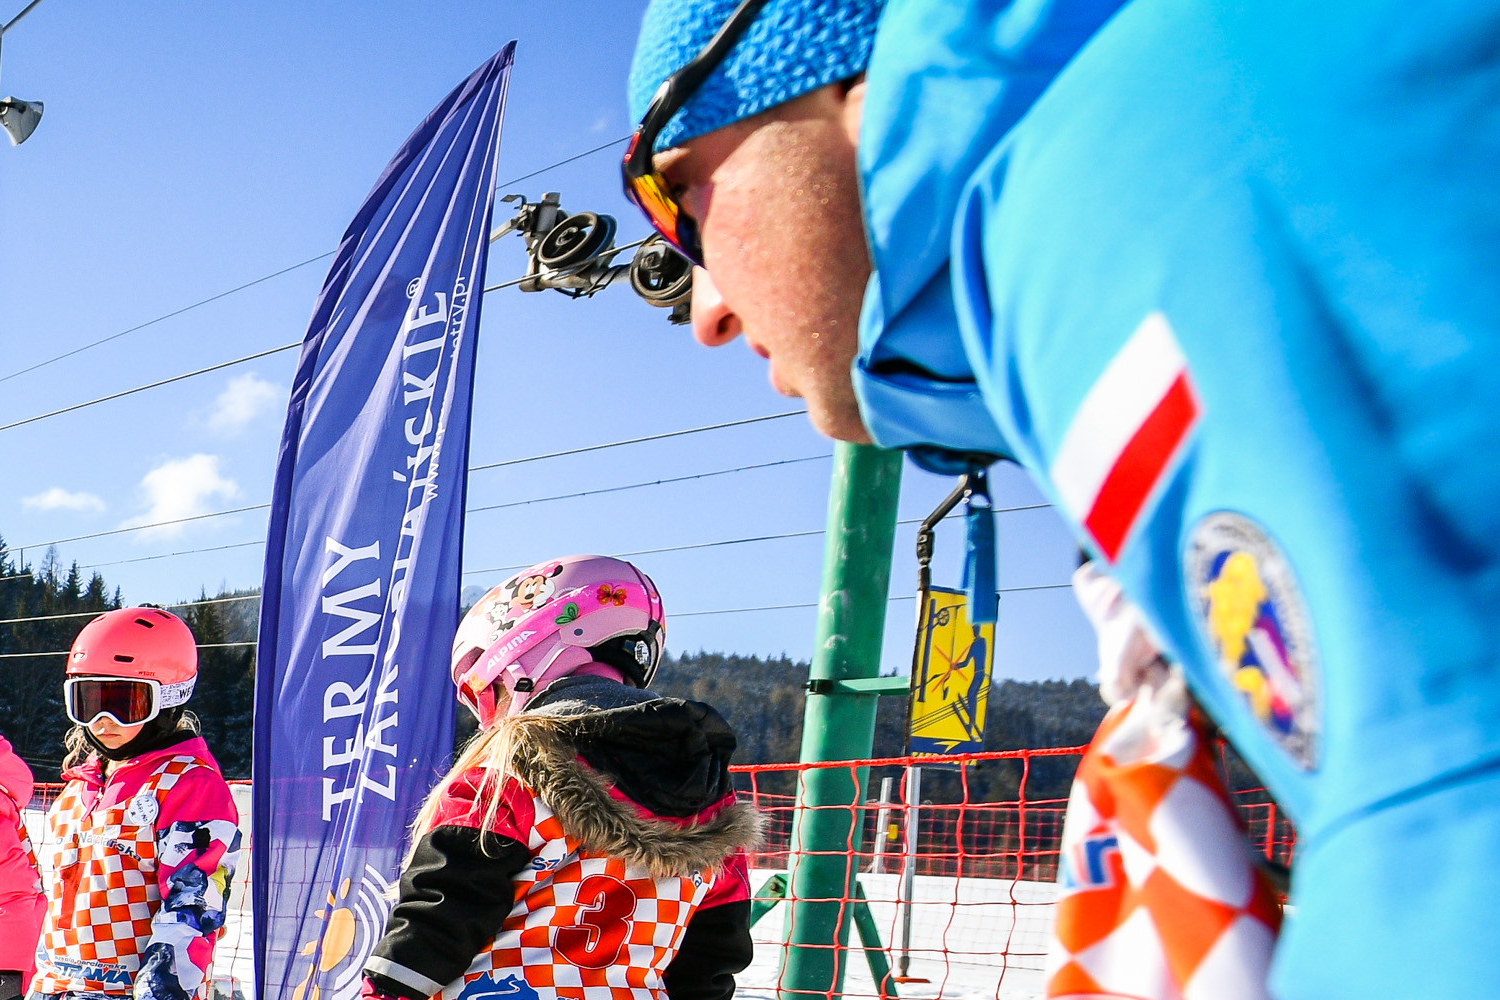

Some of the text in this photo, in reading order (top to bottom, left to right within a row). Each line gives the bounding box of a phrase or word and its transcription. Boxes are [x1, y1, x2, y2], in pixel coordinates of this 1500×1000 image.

[321, 536, 382, 822] TERMY
[486, 630, 538, 673] ALPINA
[554, 873, 637, 970] 3
